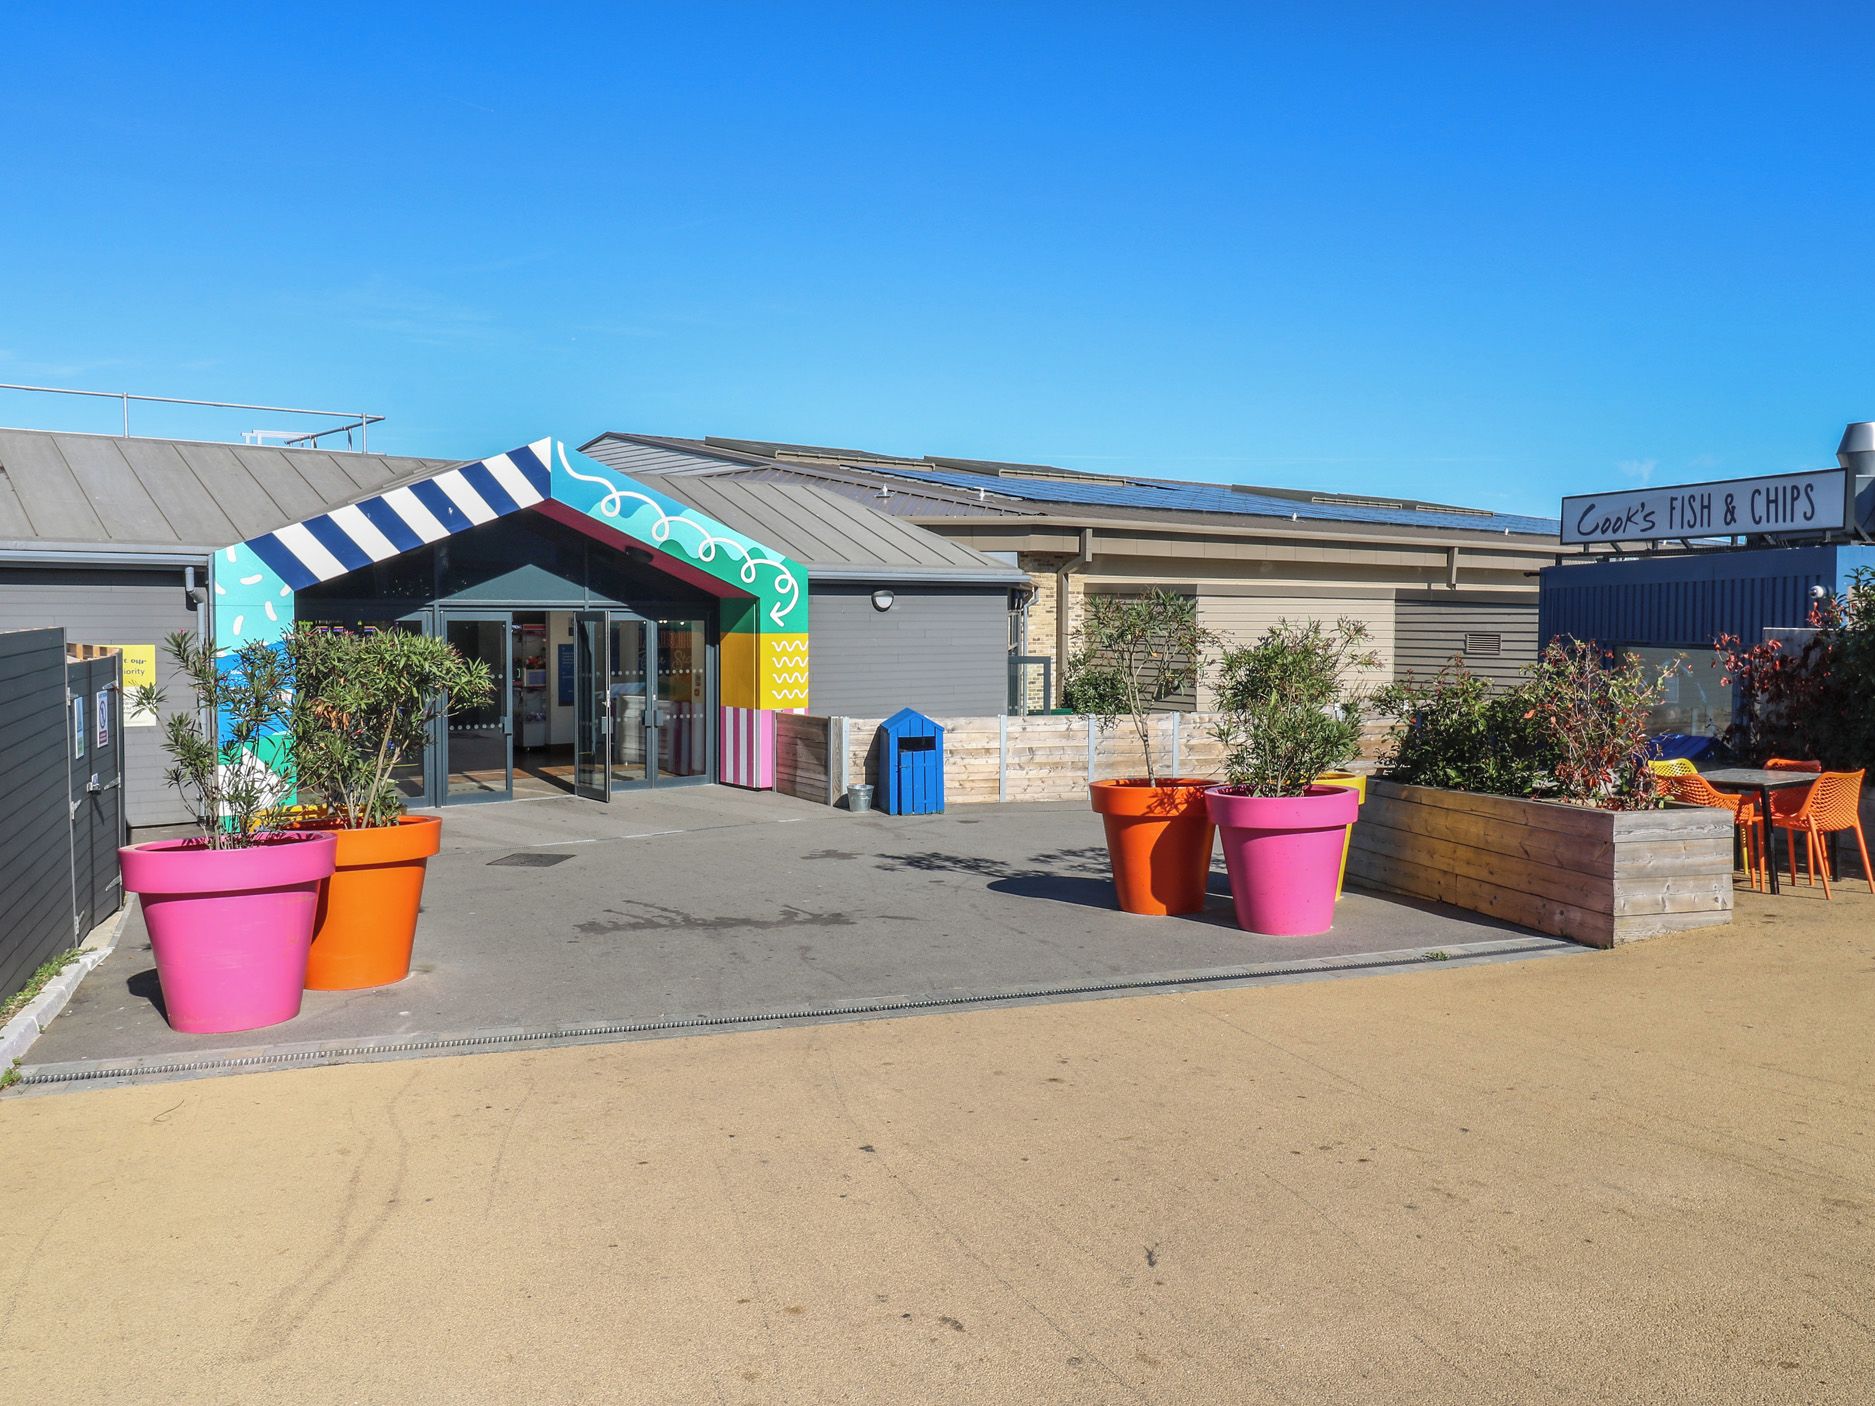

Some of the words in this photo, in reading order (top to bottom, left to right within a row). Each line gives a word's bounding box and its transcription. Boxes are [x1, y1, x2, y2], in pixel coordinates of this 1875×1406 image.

[1670, 492, 1711, 530] FISH
[1723, 493, 1737, 526] &
[1750, 483, 1815, 525] CHIPS
[123, 668, 145, 676] iority
